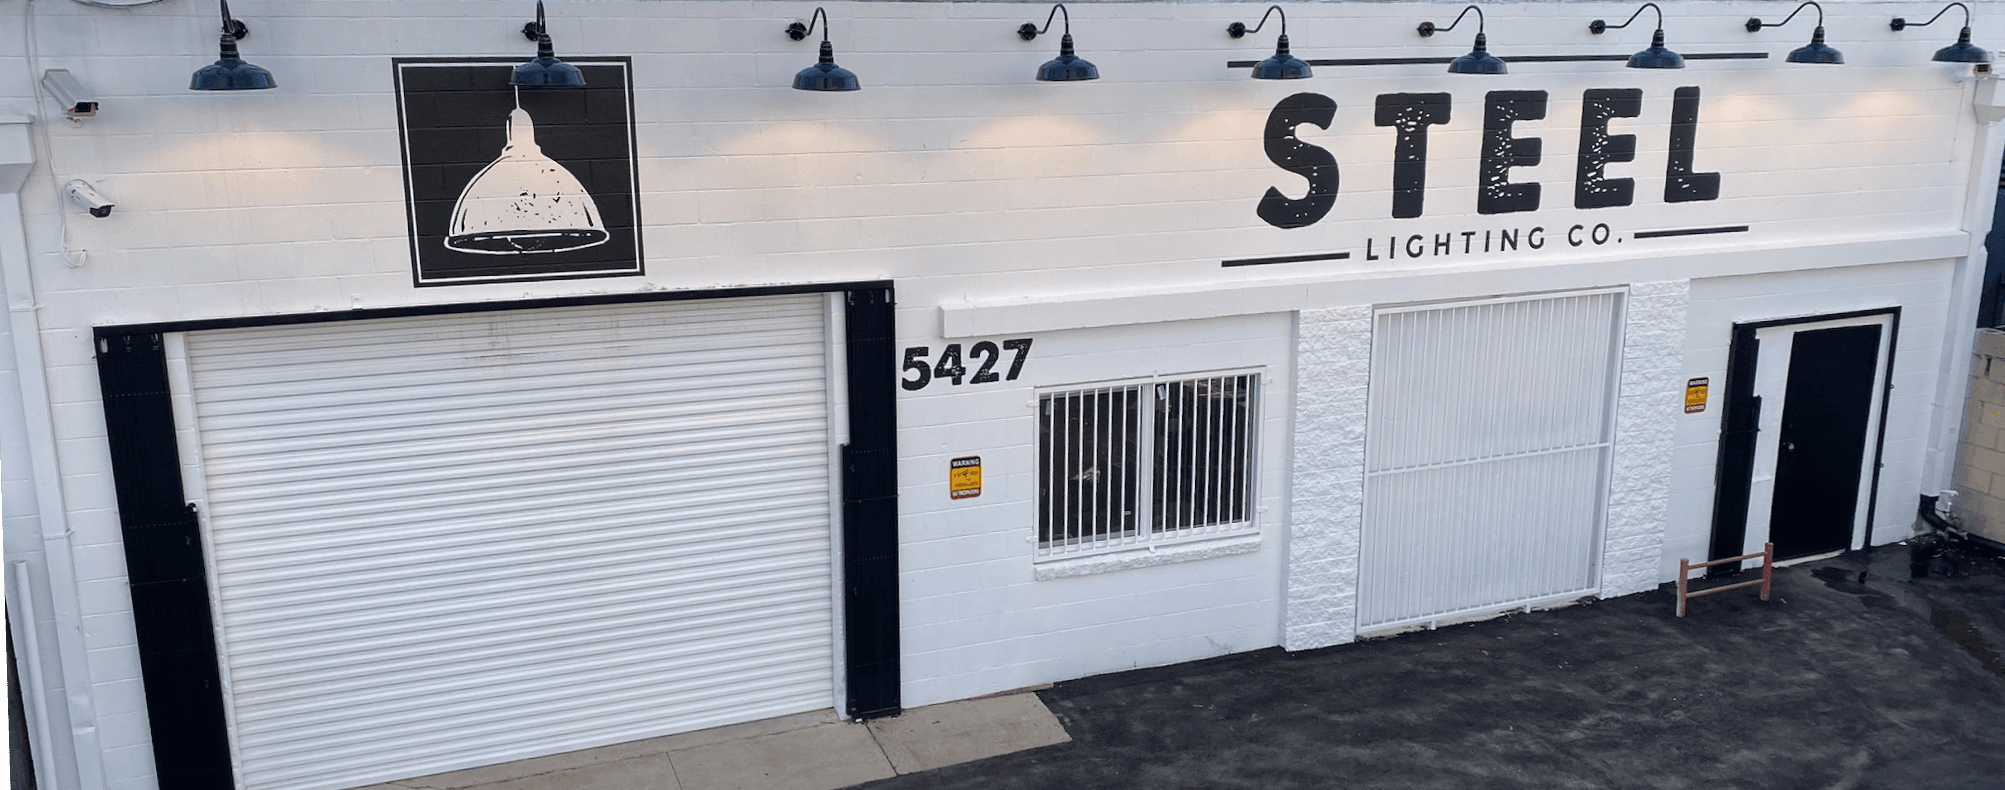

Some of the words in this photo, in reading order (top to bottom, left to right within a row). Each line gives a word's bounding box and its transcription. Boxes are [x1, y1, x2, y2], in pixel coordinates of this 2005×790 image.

[1257, 85, 1721, 230] STEEL
[1366, 226, 1546, 261] LIGHTING
[1567, 222, 1624, 248] CO.
[901, 337, 1034, 392] 5427
[952, 458, 980, 468] WARNING
